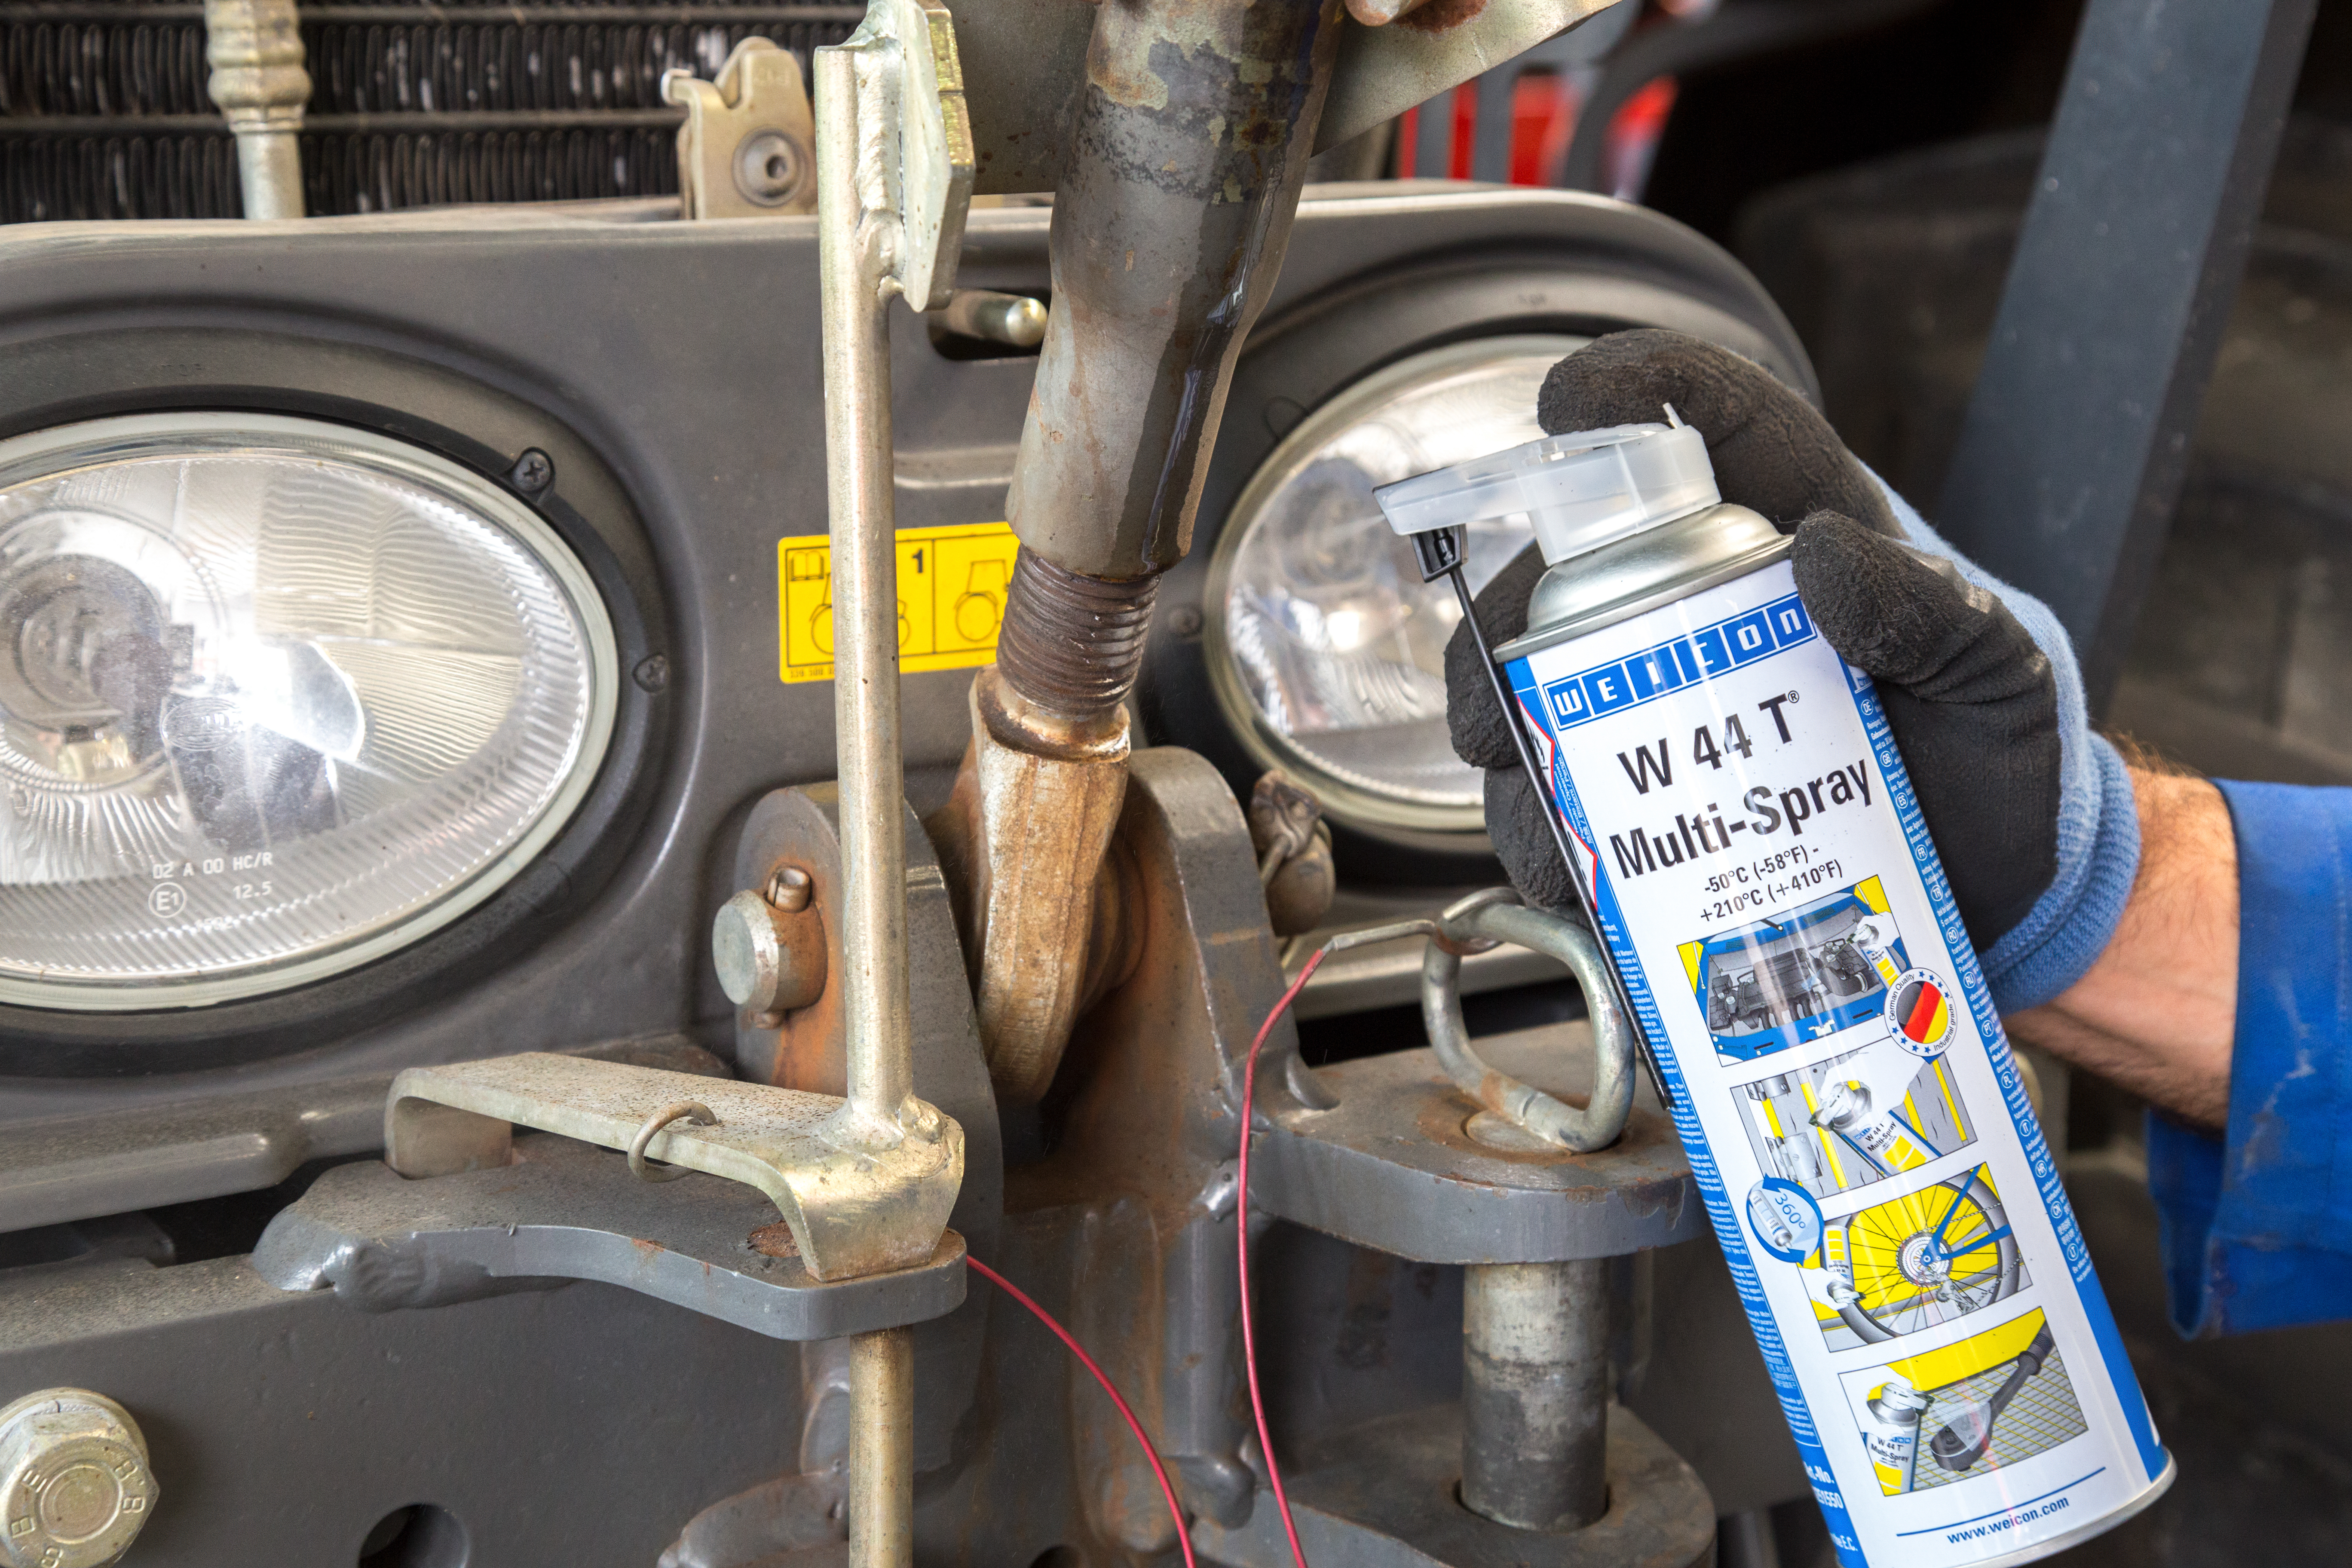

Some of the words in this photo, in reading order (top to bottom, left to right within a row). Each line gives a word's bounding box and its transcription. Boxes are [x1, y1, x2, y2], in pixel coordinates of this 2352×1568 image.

[912, 548, 924, 574] 1
[1554, 607, 1803, 717] WEICON
[1863, 701, 1871, 712] DE
[1617, 738, 1672, 794] W
[1694, 714, 1752, 769] 44
[1882, 753, 1891, 763] GB
[1555, 763, 1571, 801] Opasnost
[1558, 756, 1569, 782] Perigo
[1899, 795, 1906, 805] ES
[1572, 808, 1586, 839] Pericolo
[1609, 759, 1871, 878] Multi-Spray
[153, 863, 173, 879] 02
[183, 862, 195, 877] A
[203, 858, 224, 875] 00
[233, 852, 273, 871] HC/R
[1918, 847, 1926, 858] FR
[1705, 867, 1748, 891] -50°C
[1753, 845, 1808, 880] (-58°F)
[233, 881, 272, 900] 12.5
[1701, 889, 1763, 921] +210°C
[1768, 859, 1842, 901] (+410°F)
[1933, 887, 1941, 898] TR
[1948, 930, 1957, 940] RO
[1966, 974, 1974, 985] RU
[1890, 991, 1899, 1021] German
[1895, 974, 1914, 990] Quality
[1934, 1026, 1954, 1051] Industrial
[1984, 1023, 1991, 1033] PT
[2004, 1073, 2012, 1085] PL
[1867, 1121, 1896, 1152] Multi-Spray
[1775, 1194, 1805, 1228] 360°
[1871, 1443, 1909, 1462] Multi-Spray
[1947, 1498, 2069, 1543] www.weicon.com
